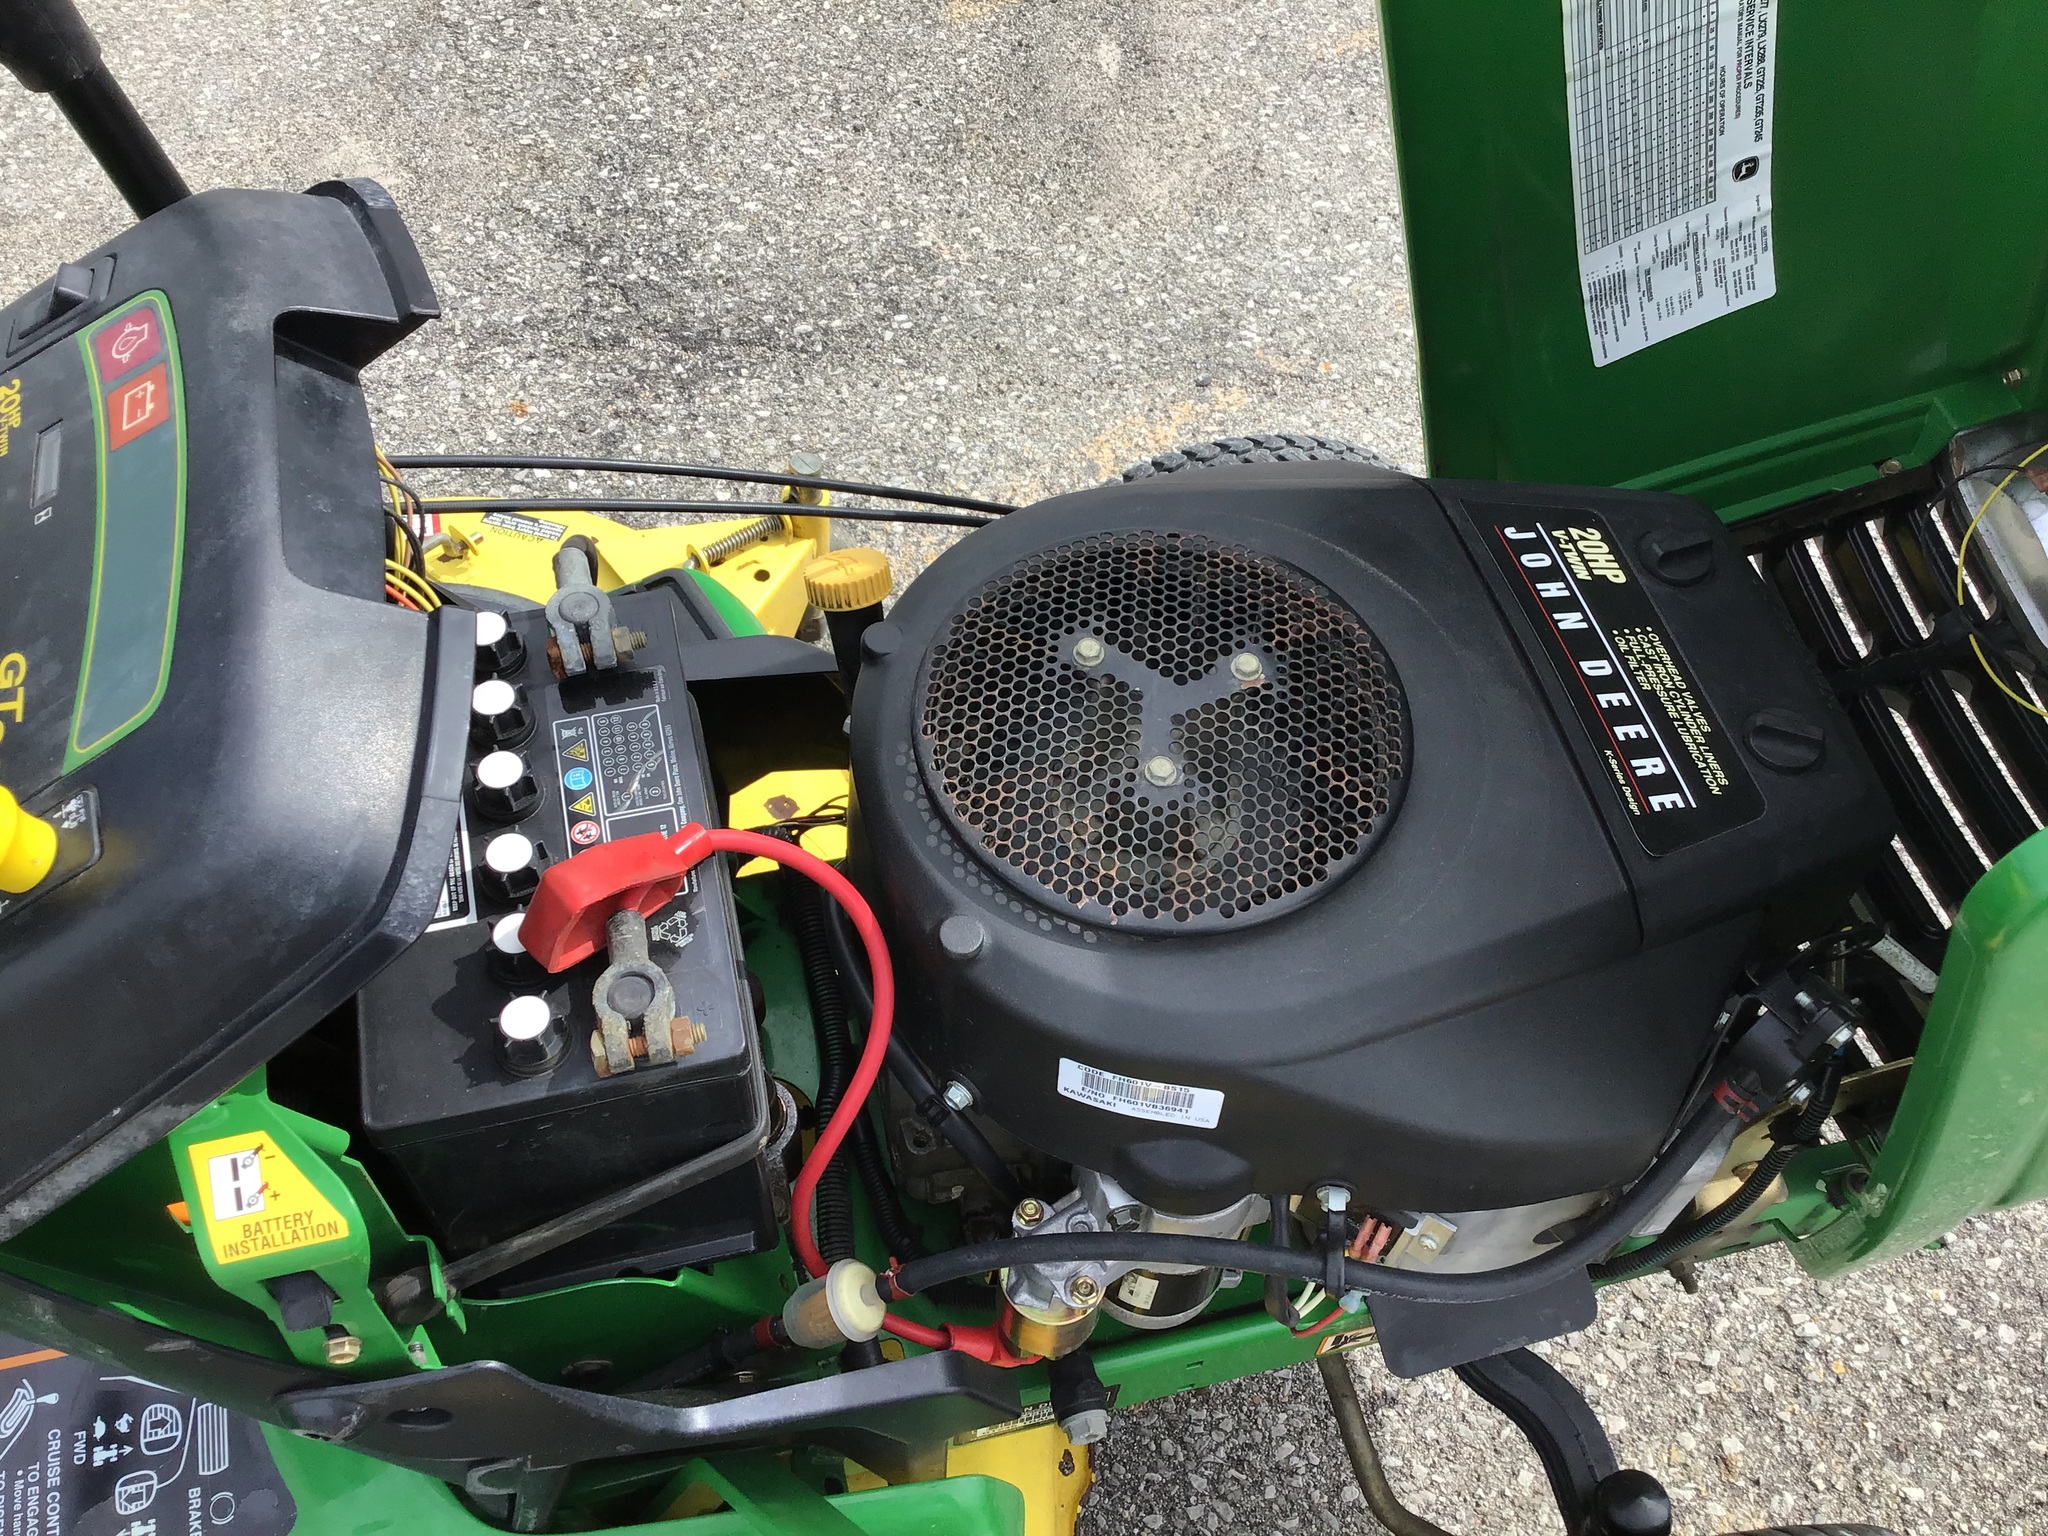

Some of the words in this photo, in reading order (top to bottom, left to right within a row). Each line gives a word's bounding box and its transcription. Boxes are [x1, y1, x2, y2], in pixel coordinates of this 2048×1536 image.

[1745, 0, 1756, 38] SERVICE
[1743, 38, 1755, 89] INTERVALS
[1719, 90, 1725, 99] OF
[490, 526, 536, 543] CAUTION
[1551, 529, 1594, 581] V-TWIN
[1567, 526, 1627, 584] 20HP
[1504, 526, 1590, 630] JOHN
[1578, 659, 1685, 812] DEERE
[1614, 636, 1630, 653] OIL
[1624, 655, 1651, 691] FILTER
[1648, 633, 1687, 689] OVERHEAD
[1681, 691, 1712, 733] VALVES
[1625, 635, 1680, 719] FULL-PRESSURE
[1673, 720, 1722, 795] LUBRICATION
[1637, 634, 1658, 661] CAST
[1653, 661, 1675, 689] IRON
[1669, 690, 1706, 743] CYLINDER
[1699, 745, 1729, 786] LINERS
[673, 775, 681, 787] Deere
[1604, 749, 1626, 785] K-Series
[1621, 786, 1641, 816] Design
[676, 796, 684, 805] One
[678, 805, 687, 825] Company,
[1077, 1064, 1104, 1077] CODE
[1063, 1086, 1117, 1108] KAWASAKI
[1131, 1106, 1176, 1118] ASSEMBLED
[1081, 1086, 1105, 1098] E/NO
[222, 1221, 339, 1259] INSTALLATION
[242, 1210, 314, 1239] BATTERY
[47, 1428, 61, 1488] CRUISE
[72, 1431, 86, 1466] FWD
[28, 1461, 40, 1483] TO
[14, 1479, 25, 1511] Move
